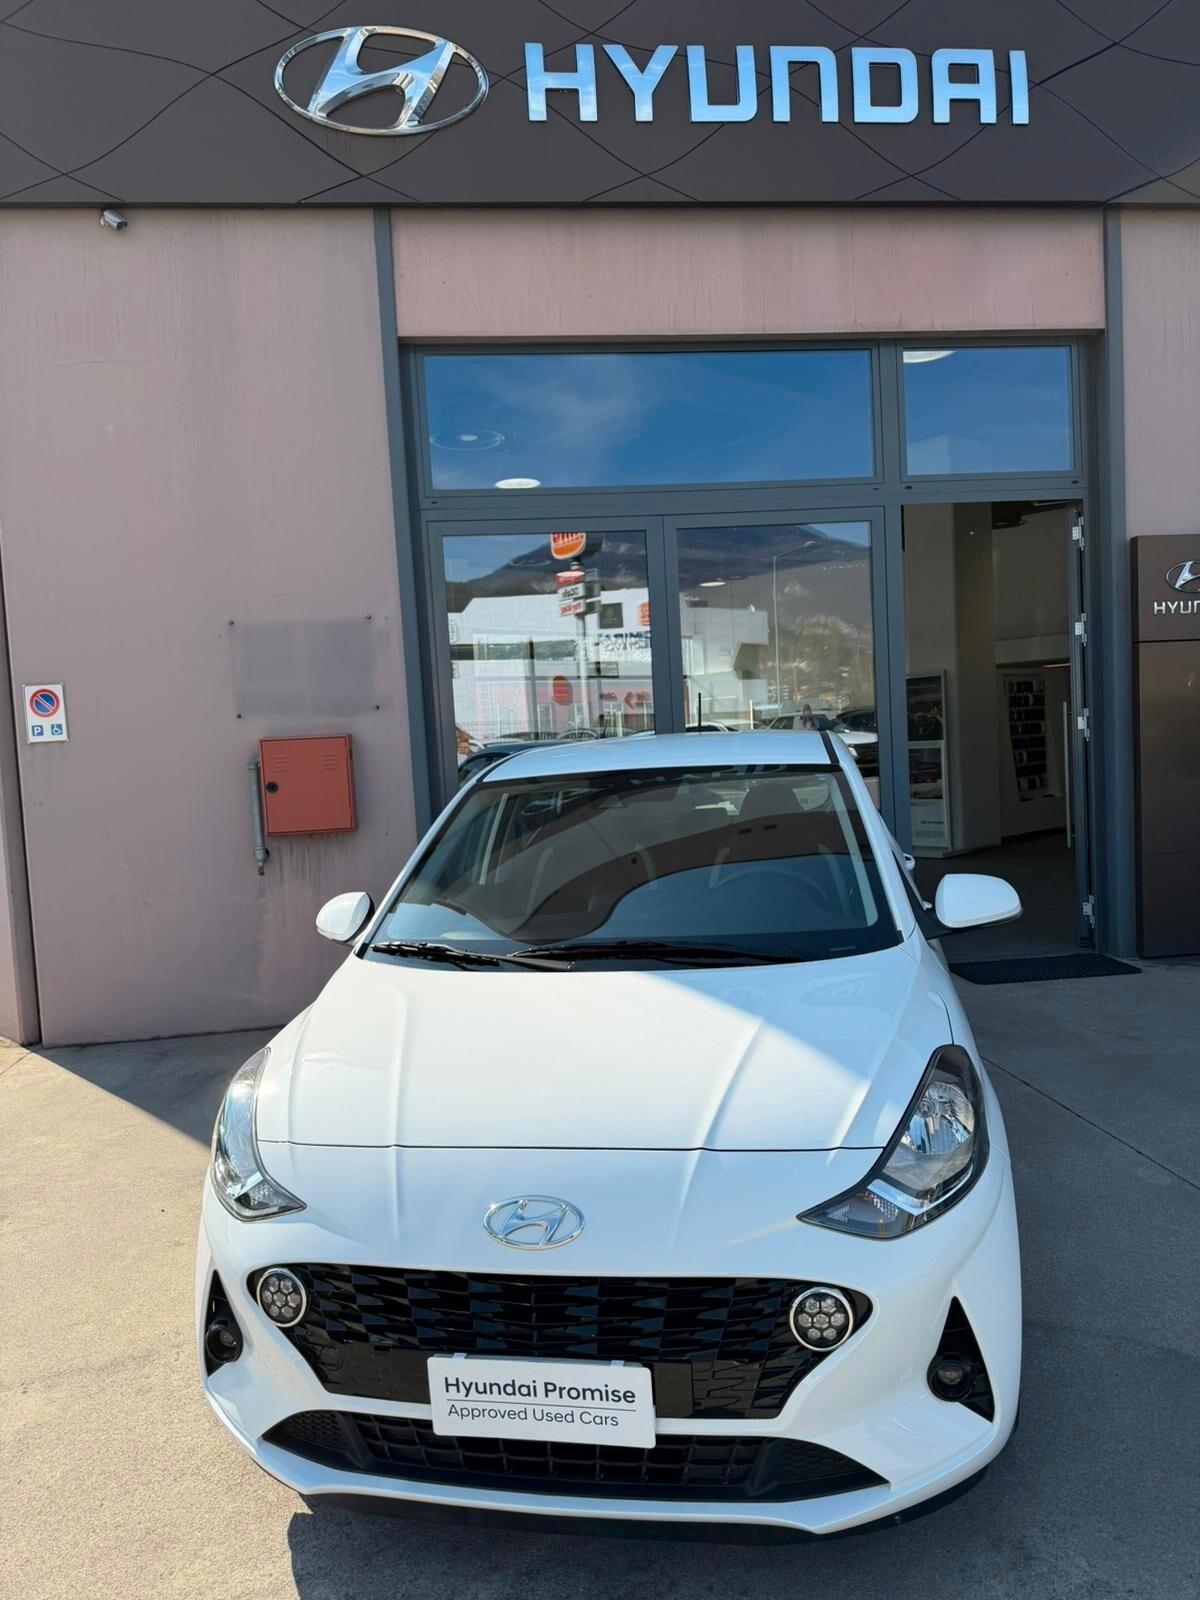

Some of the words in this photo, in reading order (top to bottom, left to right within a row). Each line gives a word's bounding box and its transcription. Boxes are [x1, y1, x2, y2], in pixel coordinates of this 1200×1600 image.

[525, 43, 1029, 125] HYUNDAI
[444, 1377, 537, 1397] Hyundai
[544, 1382, 635, 1403] Promise
[448, 1404, 527, 1421] Approved
[532, 1408, 575, 1424] Used
[579, 1411, 619, 1427] Cars
